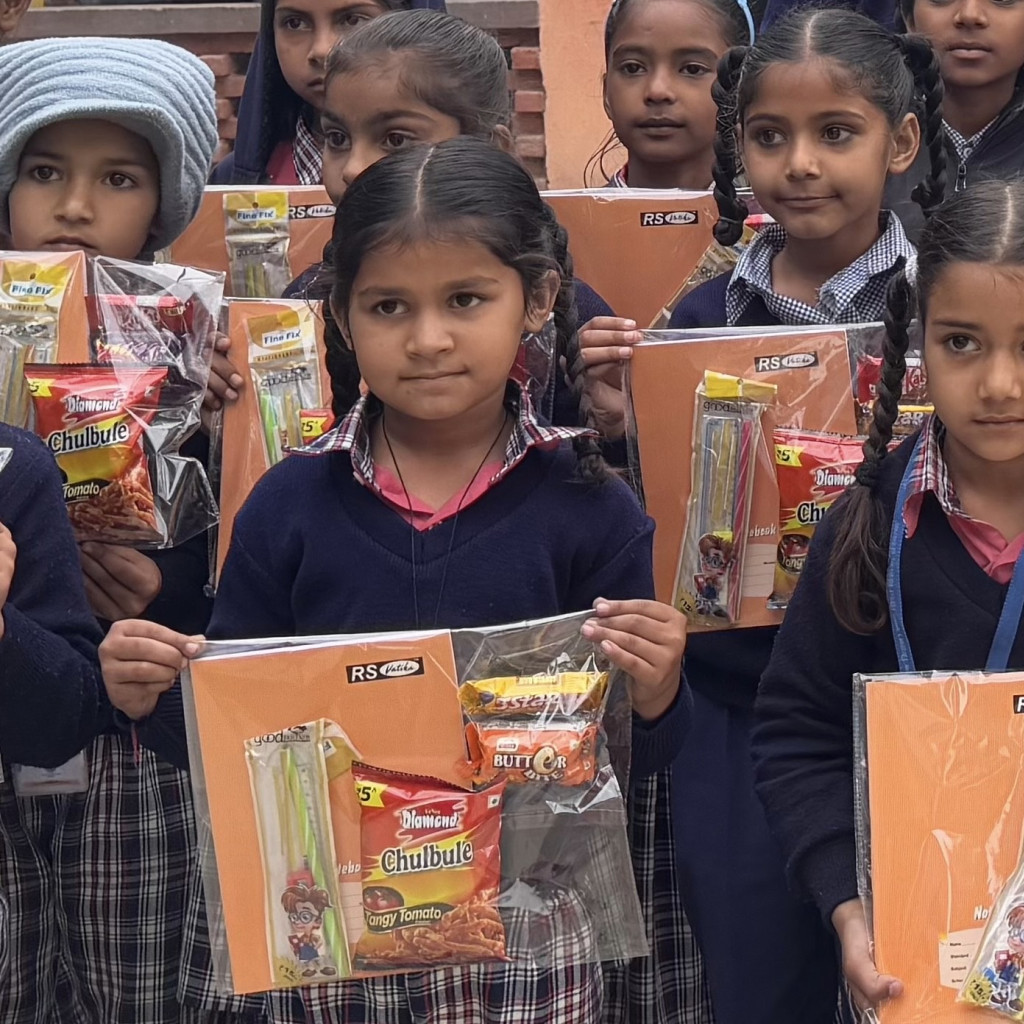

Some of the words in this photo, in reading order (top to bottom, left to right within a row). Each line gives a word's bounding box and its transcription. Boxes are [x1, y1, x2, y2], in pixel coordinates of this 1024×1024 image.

[643, 212, 664, 226] RS
[758, 356, 781, 372] RS
[47, 421, 130, 454] Chulbule
[62, 482, 100, 498] Tomato
[350, 663, 378, 682] RS
[401, 808, 459, 829] Diamond
[380, 840, 473, 874] Chulbule
[365, 911, 398, 928] Tangy
[399, 906, 442, 923] Tomato
